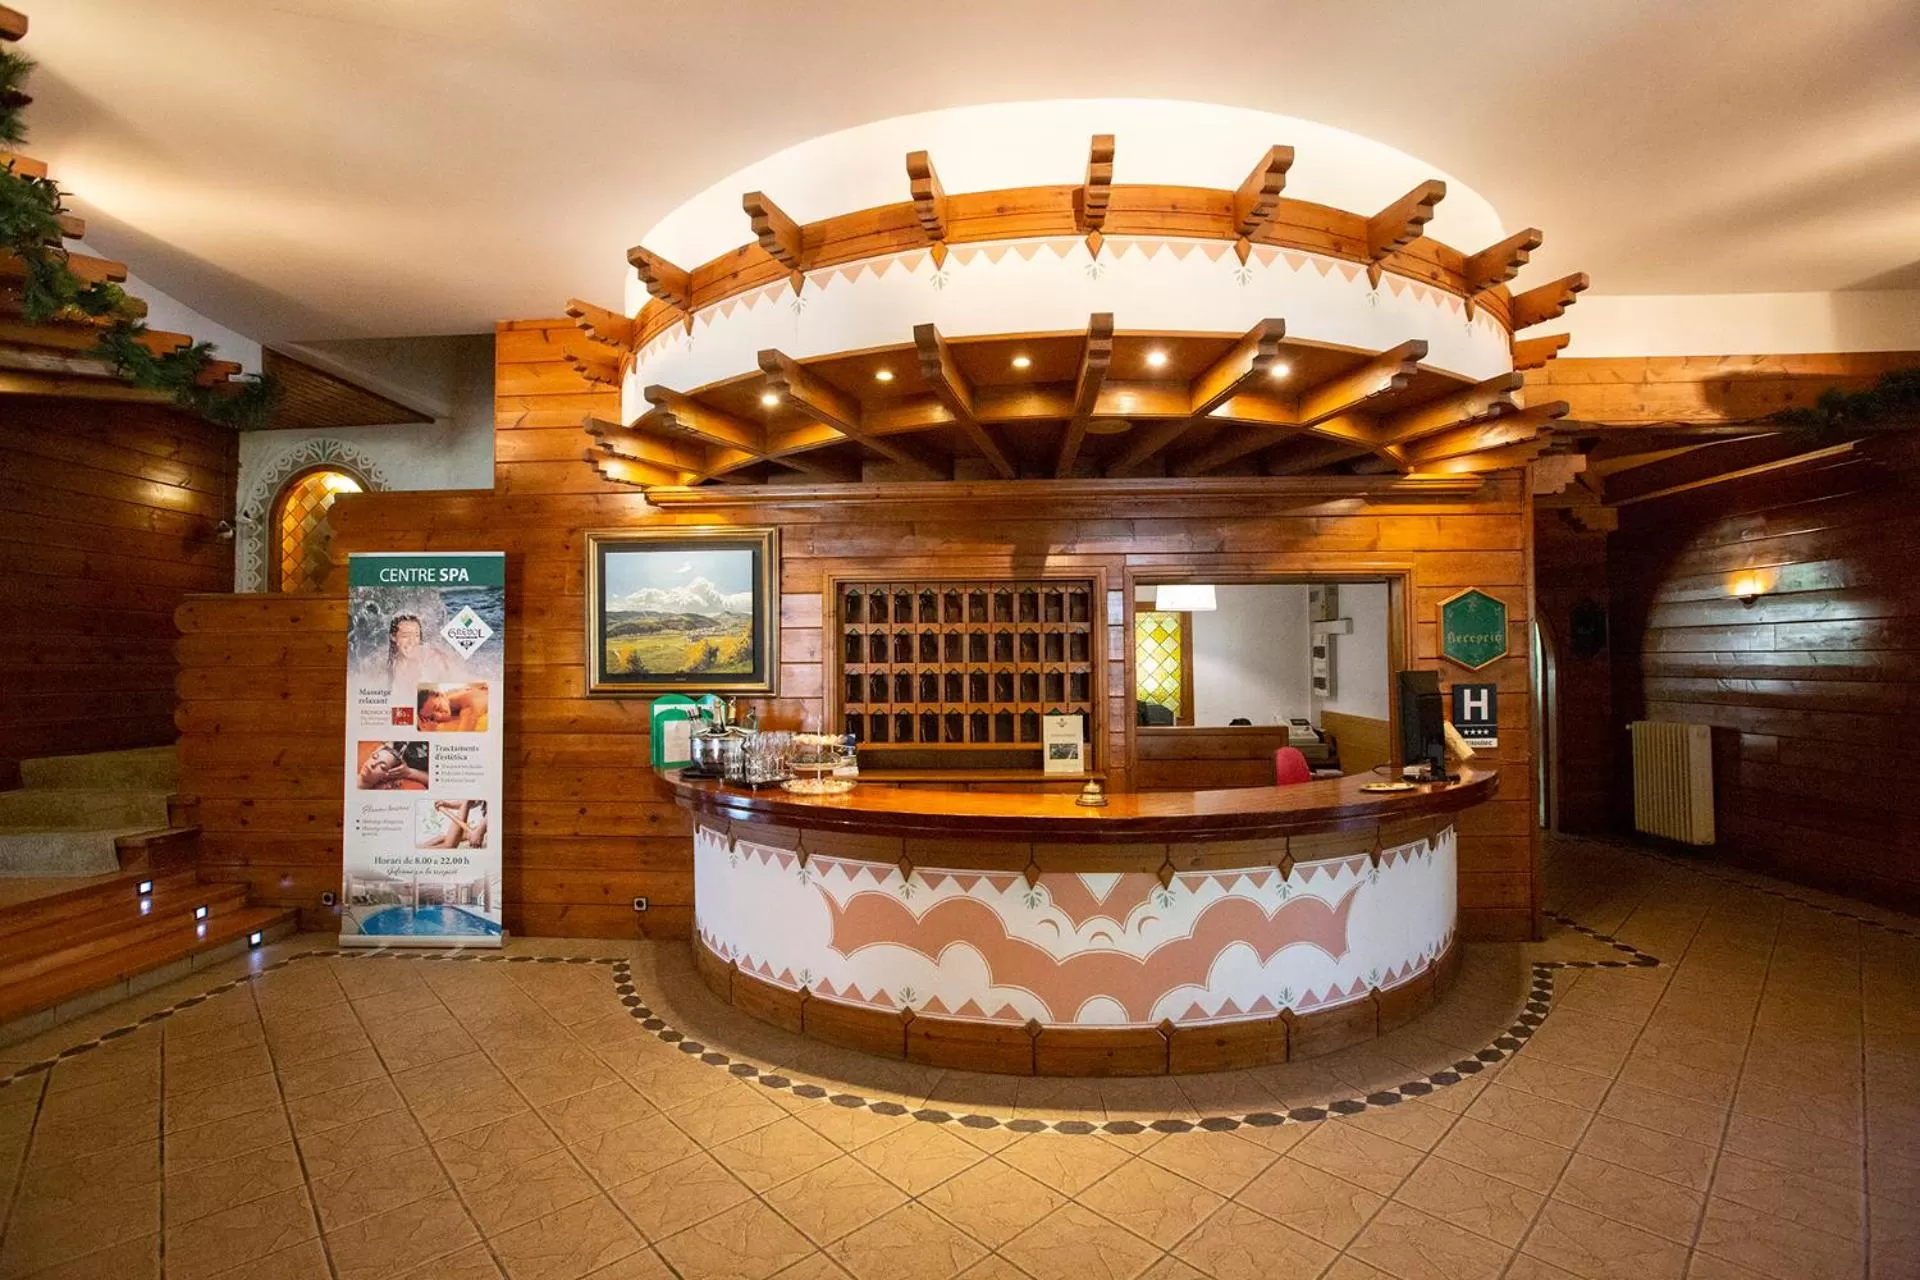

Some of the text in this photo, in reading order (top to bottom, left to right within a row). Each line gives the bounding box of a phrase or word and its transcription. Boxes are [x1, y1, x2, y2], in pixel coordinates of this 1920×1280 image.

[379, 567, 470, 582] CENTRE SPA
[1463, 688, 1488, 720] H
[374, 856, 402, 865] Horari
[403, 856, 413, 865] de
[414, 856, 432, 865] 8.00
[440, 856, 463, 865] 22.00
[464, 856, 470, 865] h
